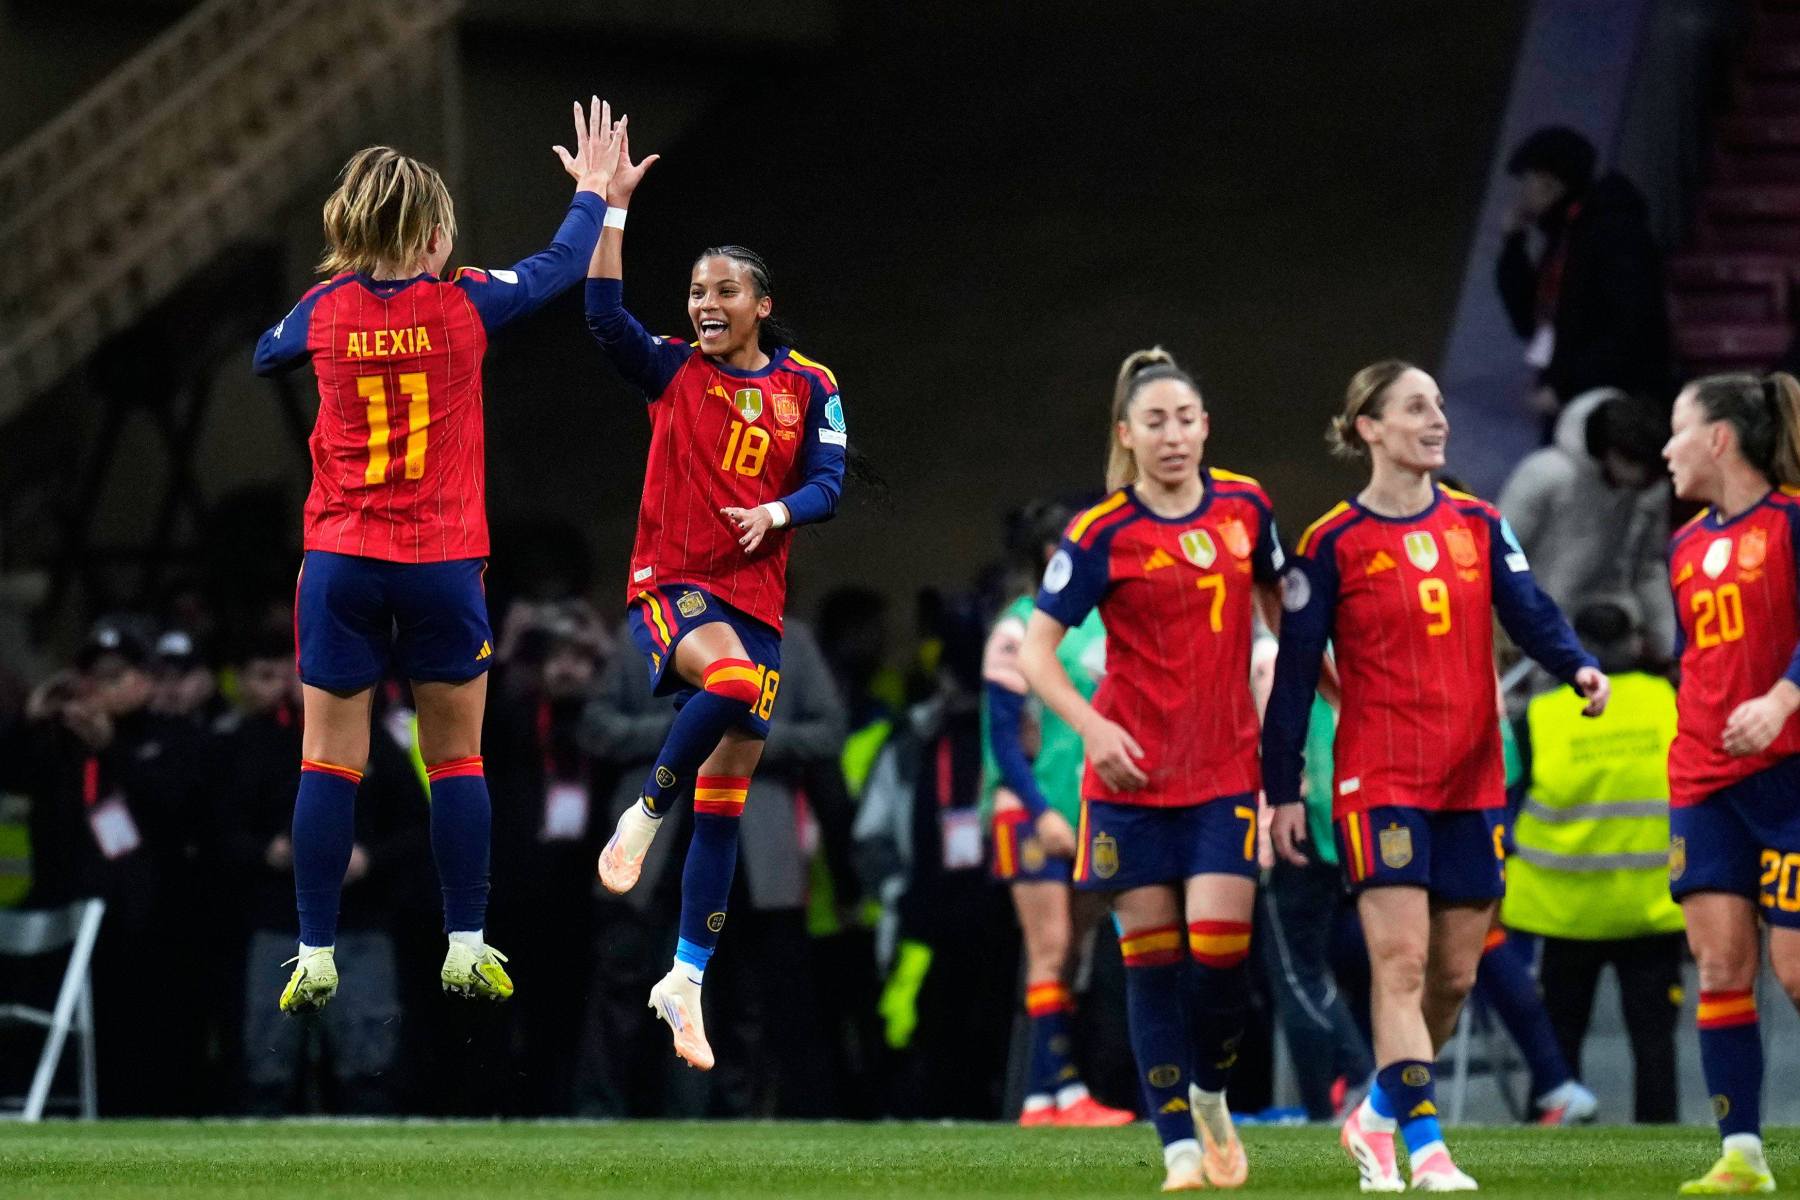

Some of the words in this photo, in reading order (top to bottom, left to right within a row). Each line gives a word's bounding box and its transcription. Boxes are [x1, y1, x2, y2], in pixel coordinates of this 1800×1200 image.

[347, 326, 431, 357] ALEXIA
[356, 372, 431, 485] 11
[721, 420, 770, 477] 18
[1197, 574, 1226, 632] 7
[1418, 577, 1452, 636] 9
[1690, 583, 1745, 649] 20
[1234, 805, 1256, 861] 7
[1760, 849, 1800, 912] 20
